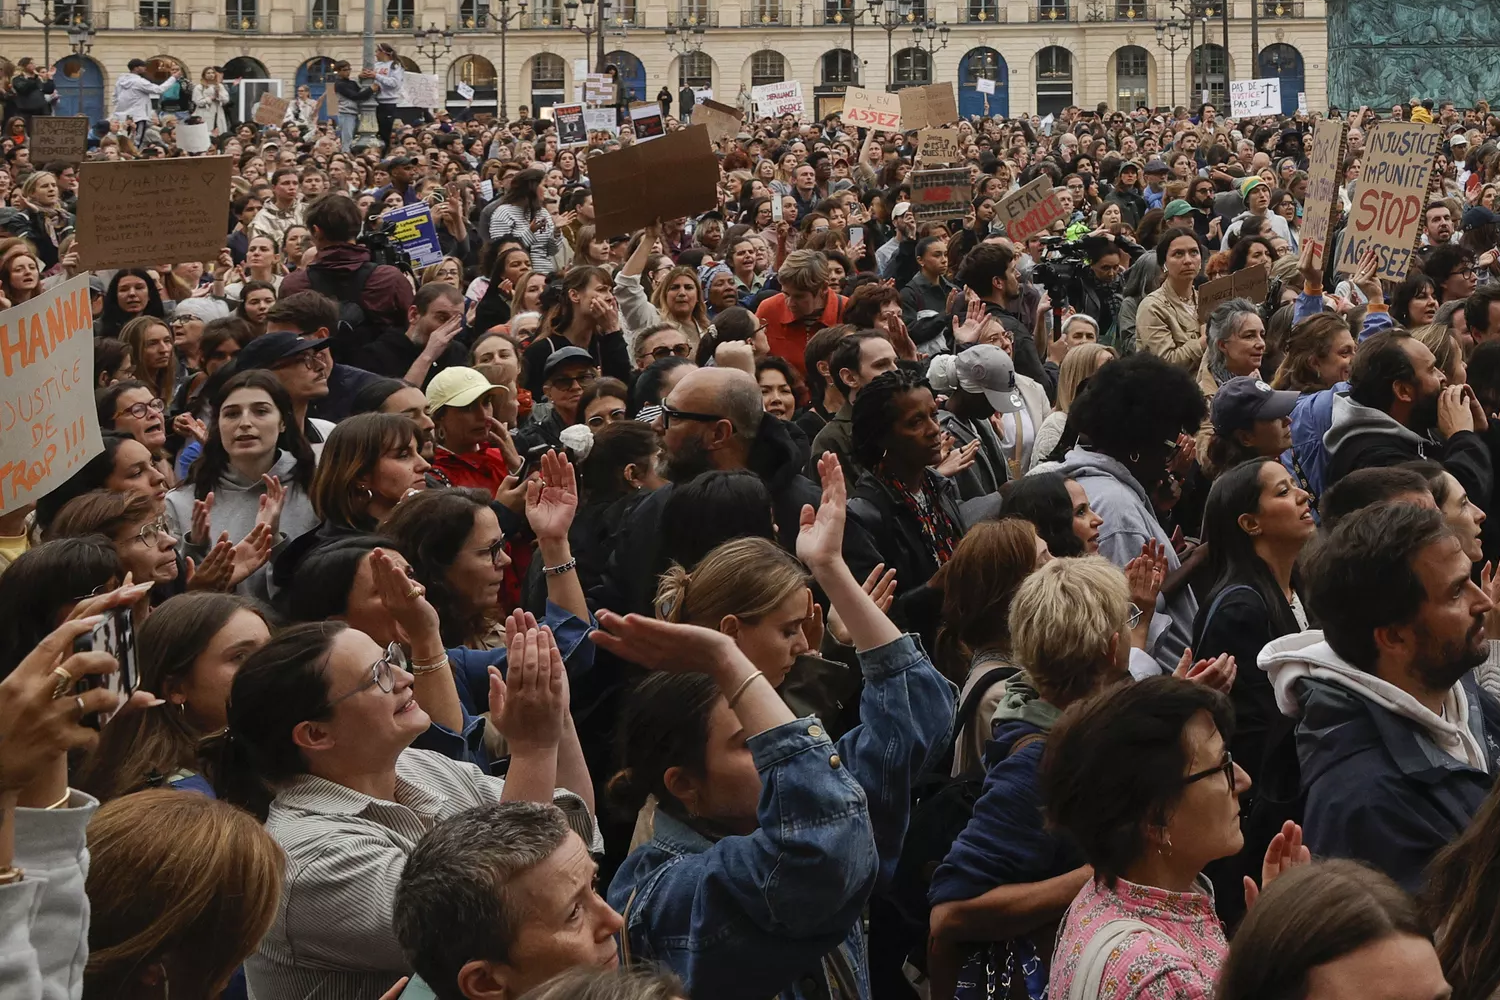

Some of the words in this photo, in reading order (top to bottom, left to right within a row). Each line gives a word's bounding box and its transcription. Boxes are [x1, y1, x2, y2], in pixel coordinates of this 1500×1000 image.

[1232, 83, 1243, 92] PAS
[1248, 82, 1257, 90] DE
[1232, 91, 1260, 100] JUSTICE
[855, 92, 869, 101] ON
[877, 96, 889, 105] EN
[1234, 100, 1247, 108] PAS
[848, 108, 899, 127] ASSEZ
[109, 174, 190, 193] LYHANNA
[1355, 189, 1421, 238] STOP
[32, 413, 58, 449] DE
[0, 444, 57, 510] TROP
